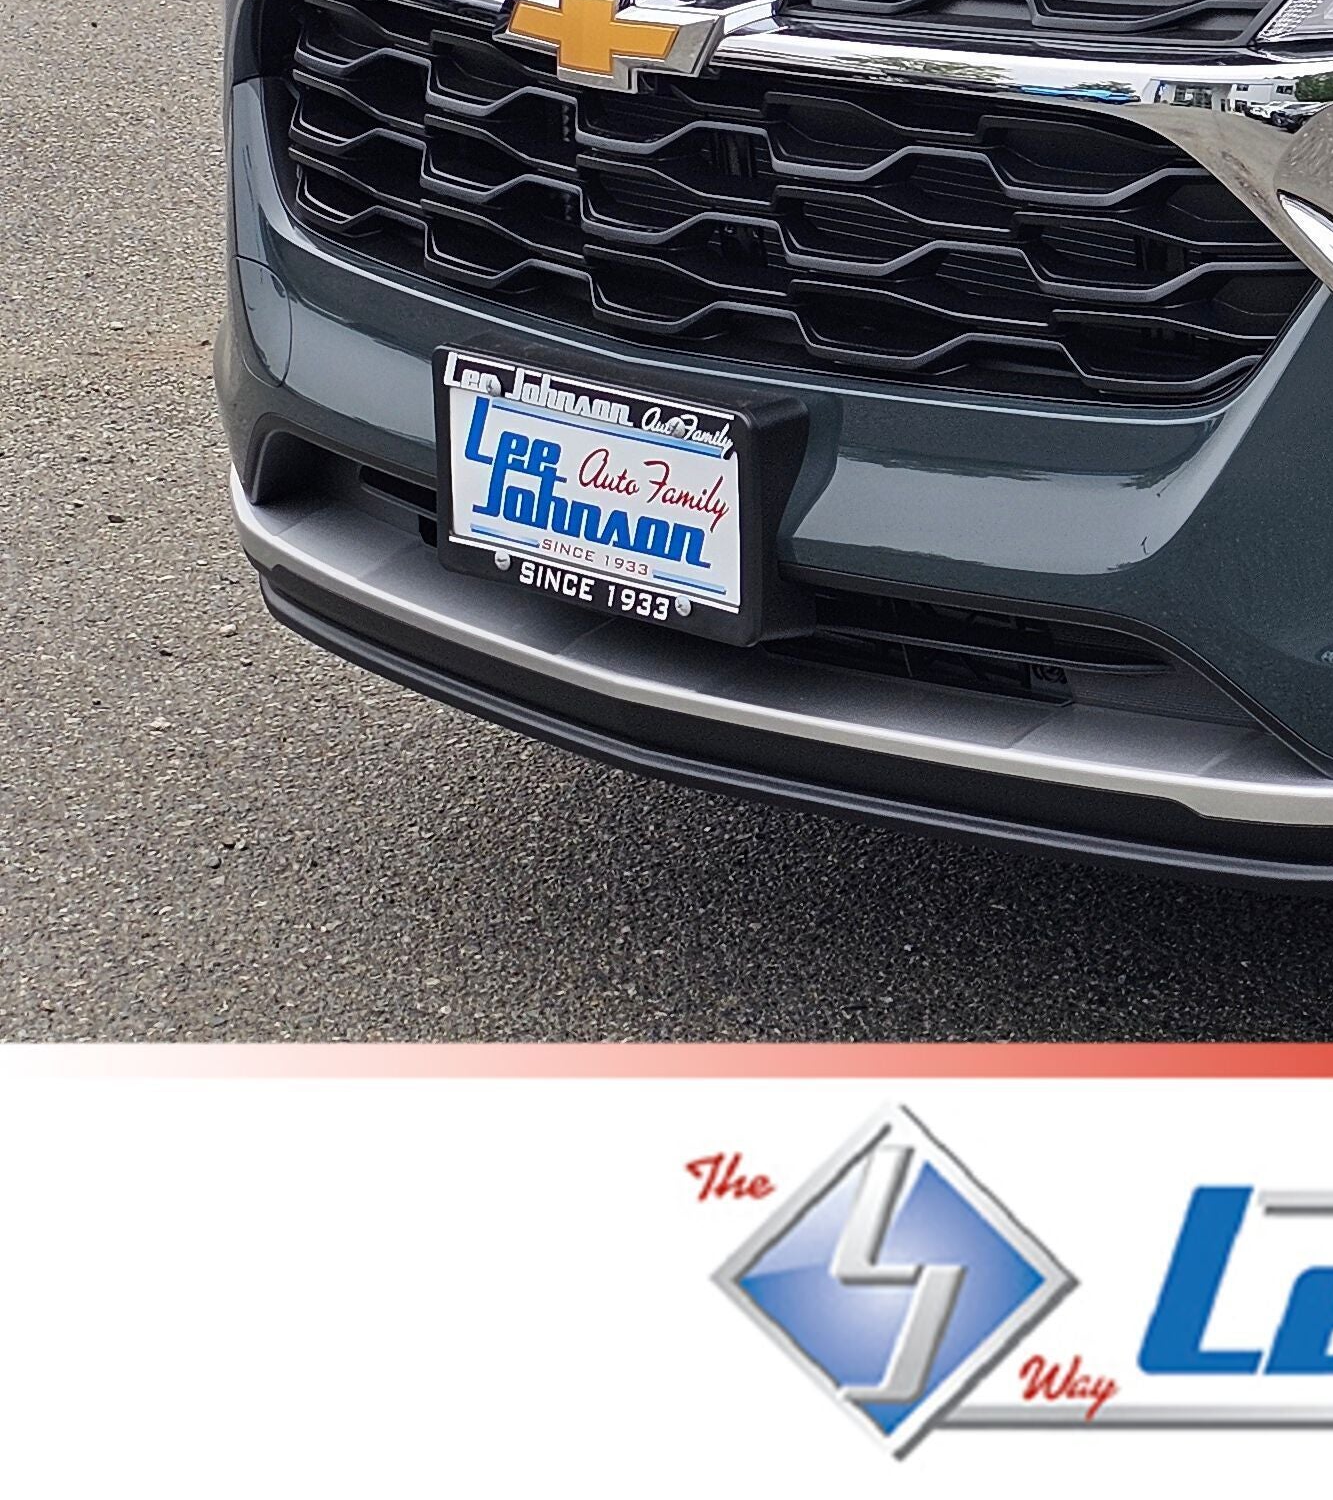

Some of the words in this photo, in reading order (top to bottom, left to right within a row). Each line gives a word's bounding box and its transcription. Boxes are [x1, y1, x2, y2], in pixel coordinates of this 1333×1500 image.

[504, 367, 634, 427] Johnson
[680, 413, 734, 460] Family
[464, 396, 567, 484] Lee
[578, 448, 640, 496] Auto
[643, 460, 729, 534] Family
[472, 462, 711, 569] Johnson
[541, 537, 595, 563] SINCE
[604, 553, 649, 577] 1933
[519, 562, 593, 602] SINCE
[606, 584, 669, 621] 1933
